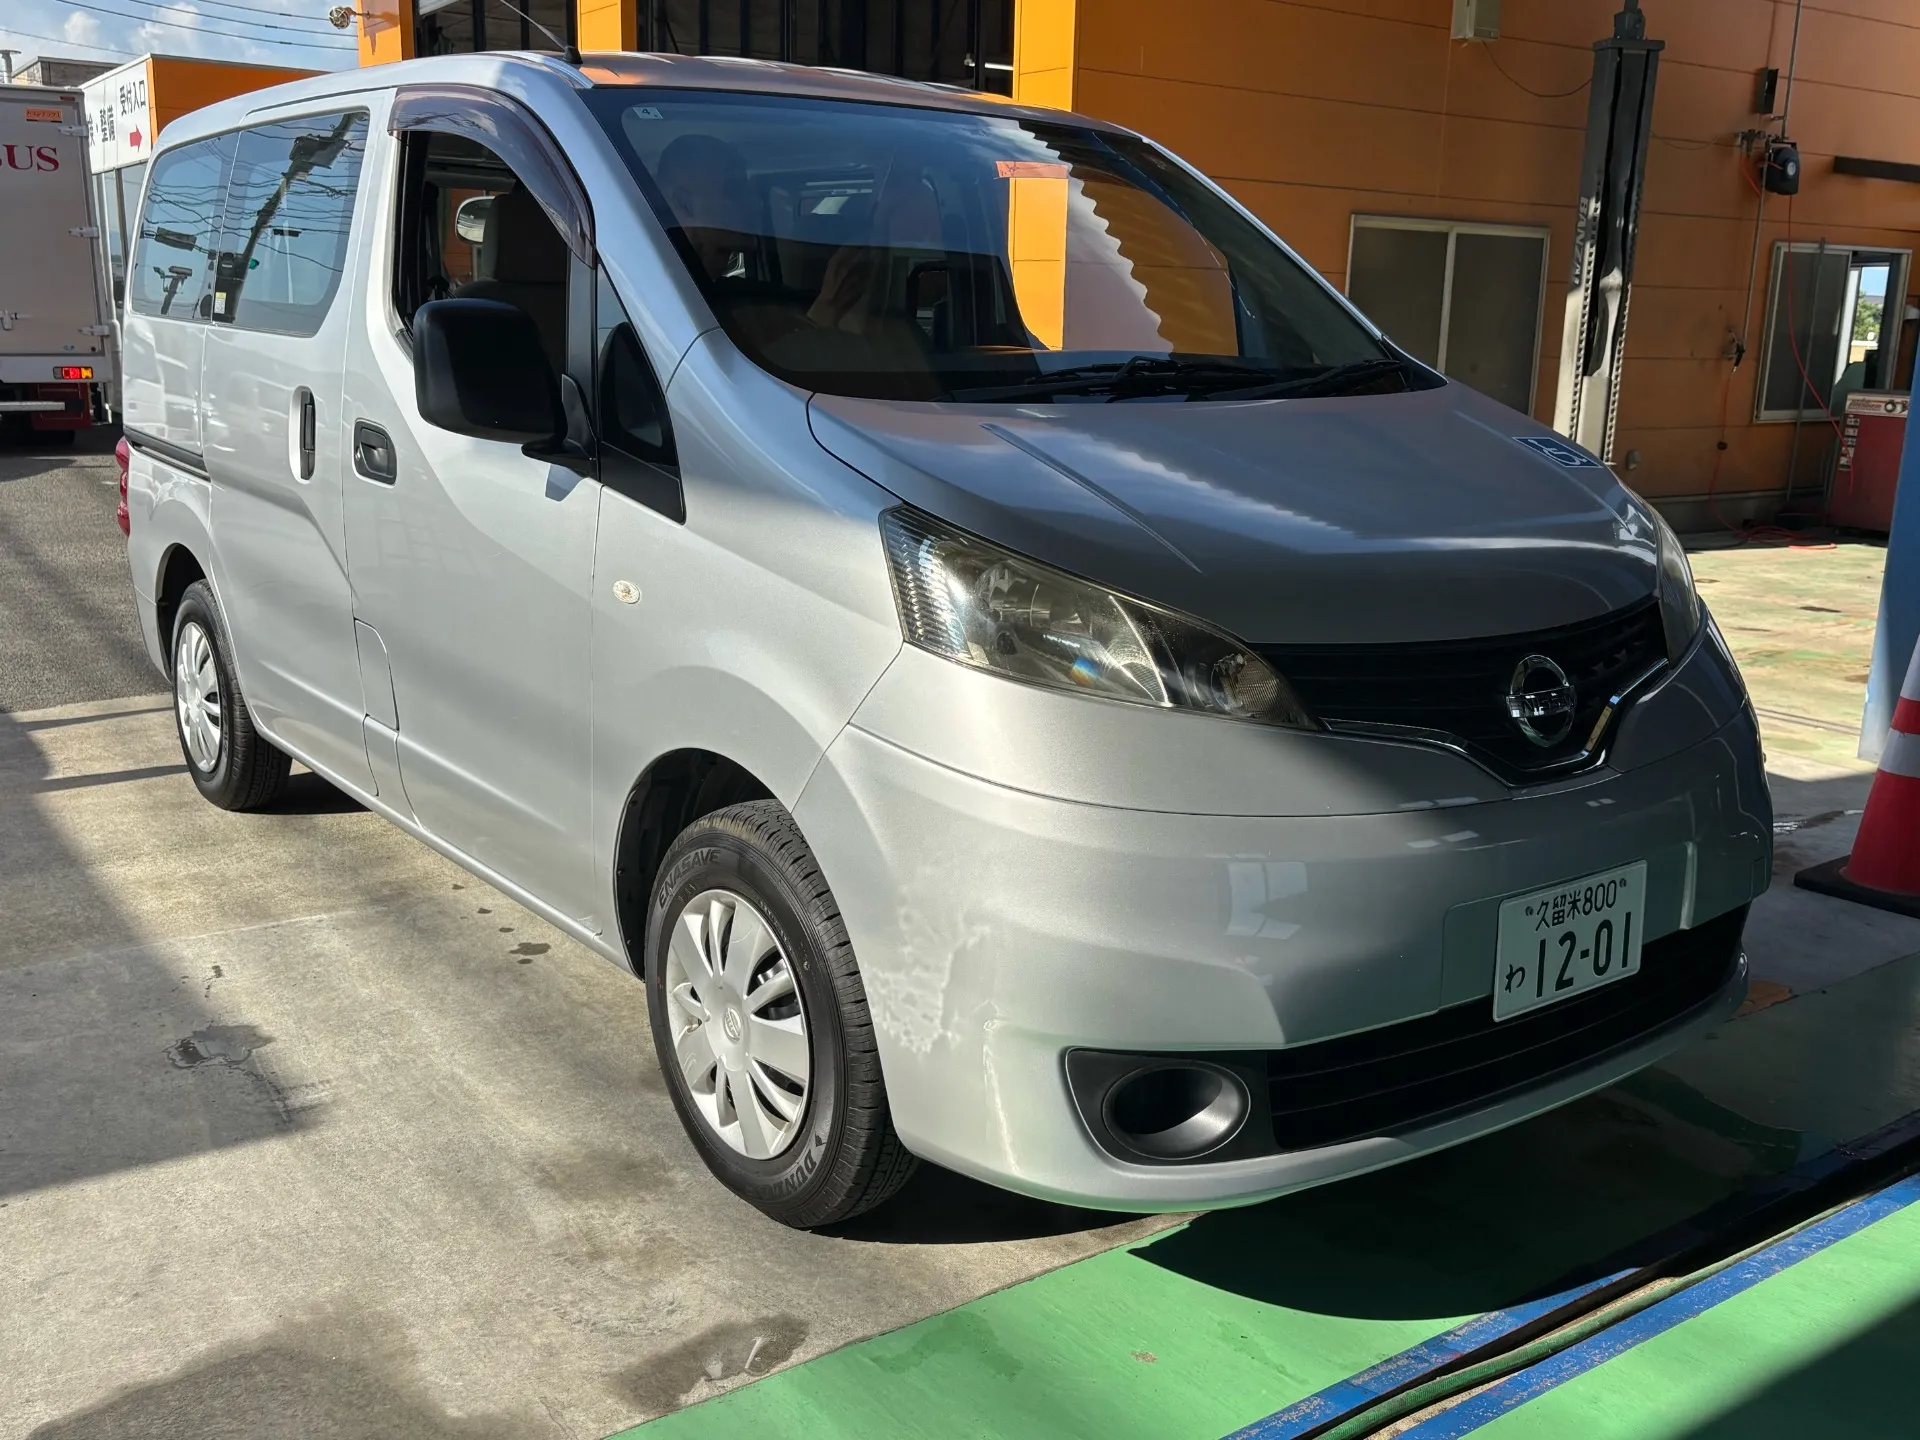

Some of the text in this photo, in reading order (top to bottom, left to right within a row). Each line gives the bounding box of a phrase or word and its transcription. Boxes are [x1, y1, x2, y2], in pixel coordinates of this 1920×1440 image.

[119, 79, 147, 116] 受付入口
[0, 144, 59, 172] US
[658, 848, 721, 909] ENASAVE
[1504, 911, 1632, 998] わ 12-01
